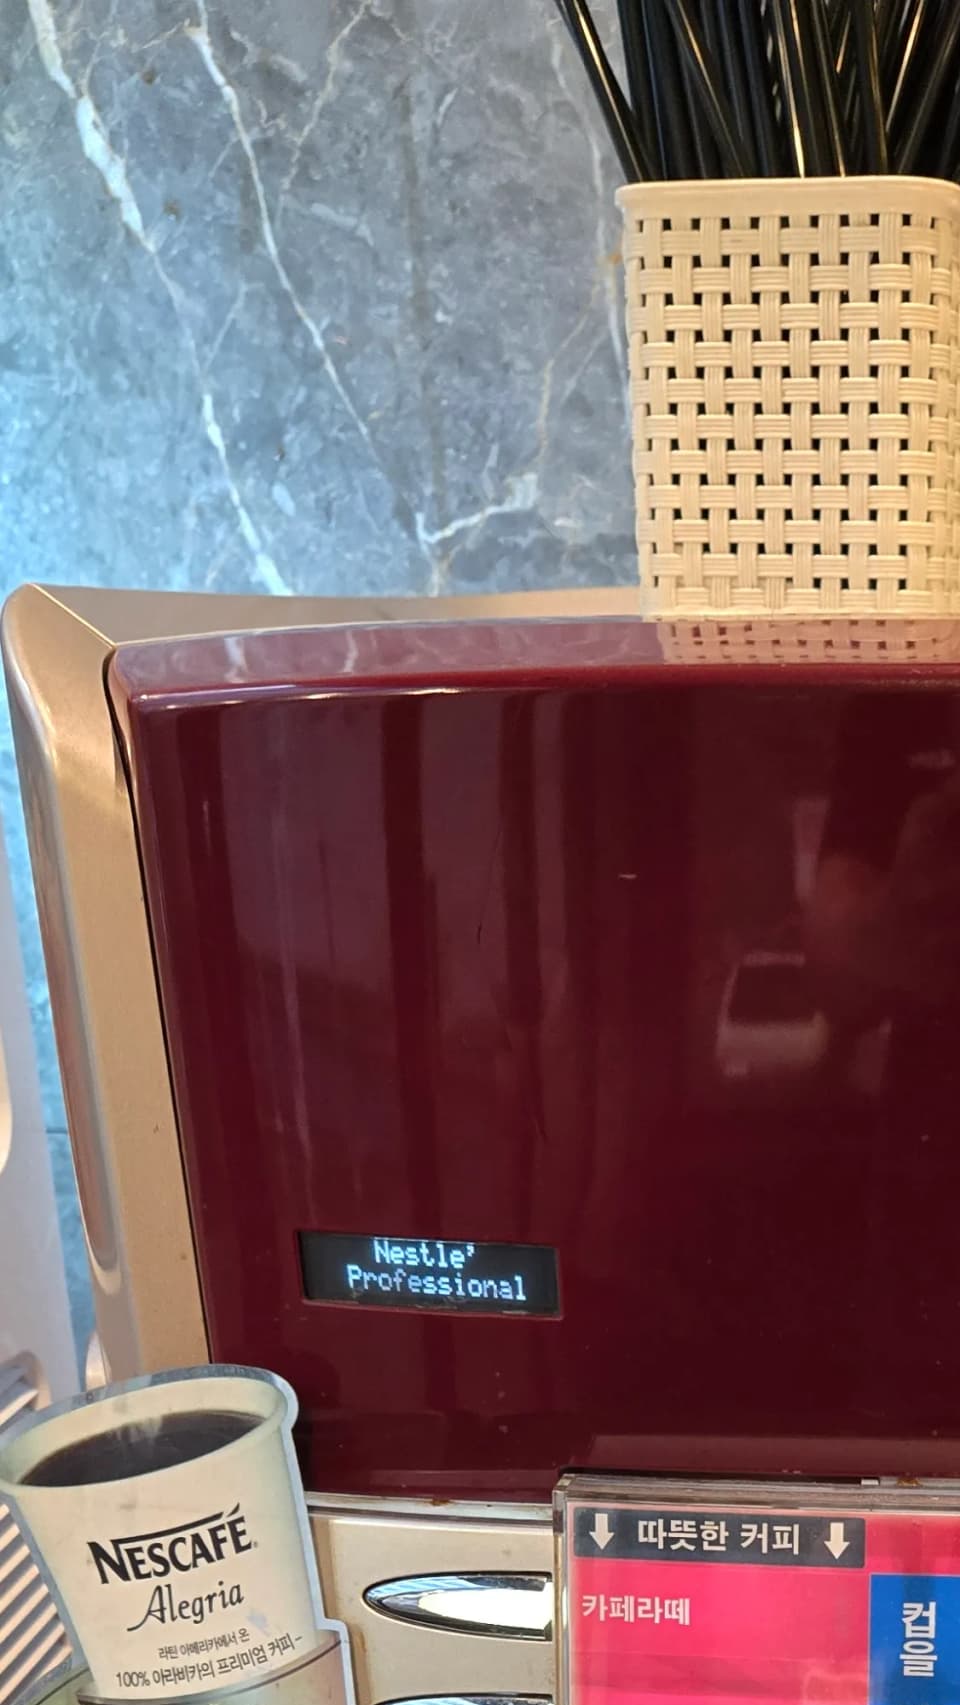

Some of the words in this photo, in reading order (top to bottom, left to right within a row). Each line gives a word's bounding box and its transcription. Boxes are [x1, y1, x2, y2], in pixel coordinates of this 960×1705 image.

[346, 1264, 527, 1300] Professional
[87, 1502, 252, 1584] NESCAFÉ
[638, 1519, 729, 1551] 따뜻한
[740, 1523, 800, 1555] 커피
[127, 1580, 244, 1632] Alegria
[582, 1595, 691, 1626] 카페라떼
[158, 1646, 179, 1661] 라틴
[180, 1633, 238, 1657] 아메리카에서
[238, 1628, 250, 1643] 온
[899, 1602, 938, 1677] 컵을
[115, 1671, 150, 1688] 100%
[152, 1661, 215, 1686] 아라비카의
[217, 1644, 268, 1674] 프리미엄
